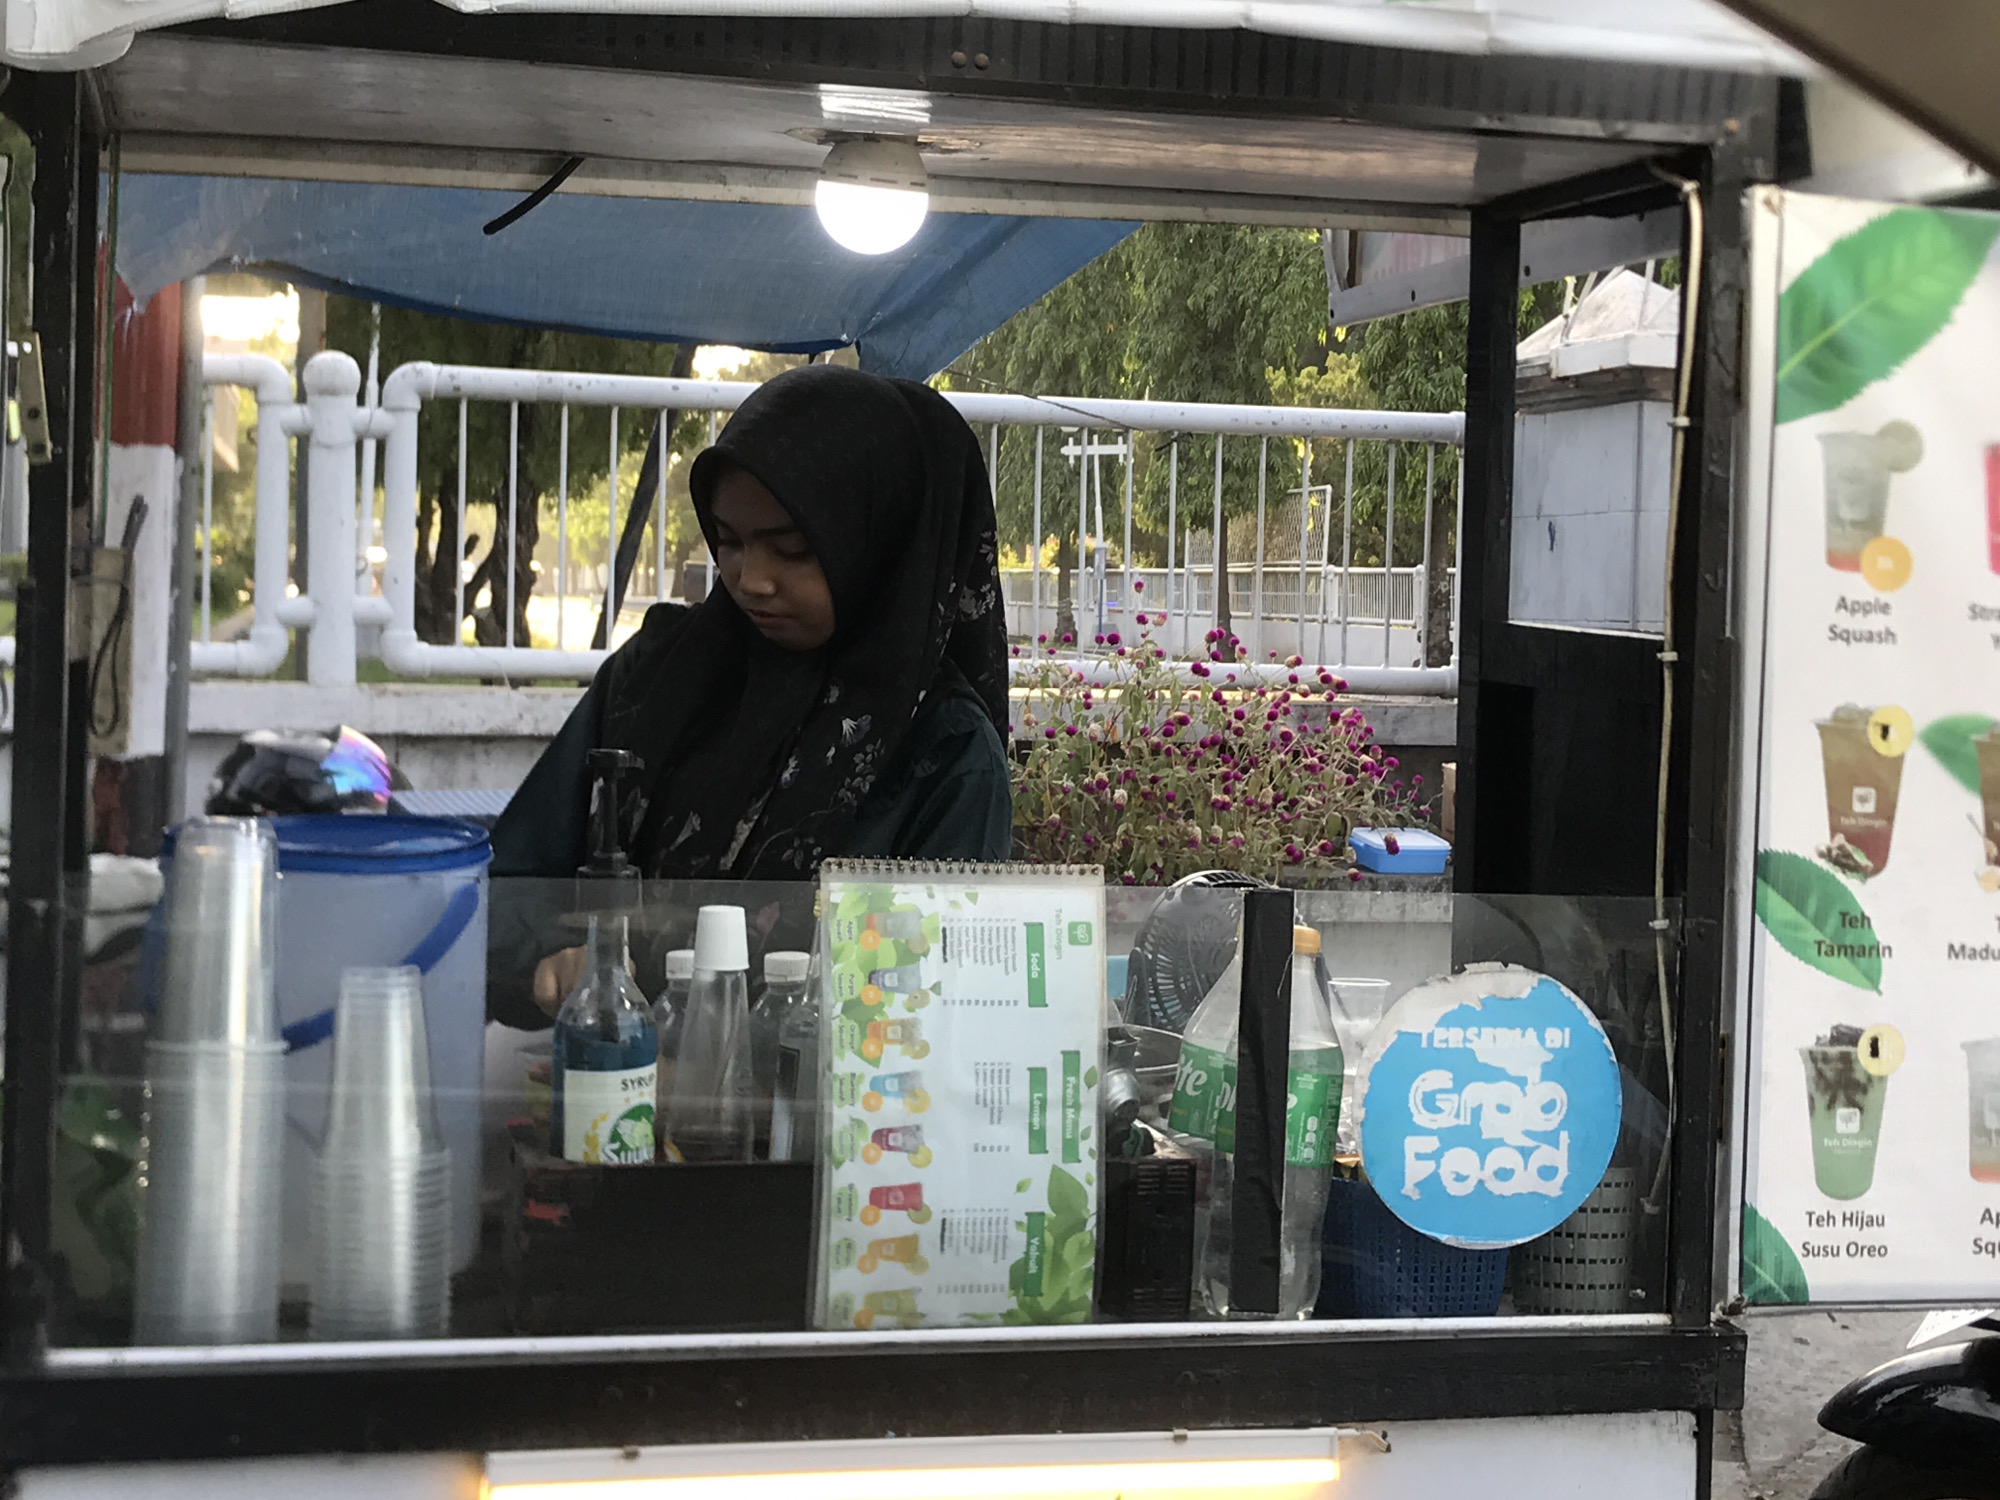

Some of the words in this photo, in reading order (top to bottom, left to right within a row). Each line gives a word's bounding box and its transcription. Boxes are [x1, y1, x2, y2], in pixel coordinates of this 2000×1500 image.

[1835, 595, 1892, 618] Apple
[1827, 624, 1897, 646] Squash
[1839, 911, 1871, 929] Teh
[1814, 939, 1892, 958] Tamarin
[1031, 952, 1040, 978] Soda
[1544, 1027, 1570, 1048] DI
[1033, 1093, 1042, 1130] Lemon
[1401, 1131, 1571, 1199] Food
[1805, 1210, 1836, 1228] Teh
[1841, 1209, 1885, 1231] Hijau
[1801, 1241, 1840, 1258] Susu
[1845, 1241, 1889, 1258] Oreo
[1972, 1237, 2000, 1258] Sq
